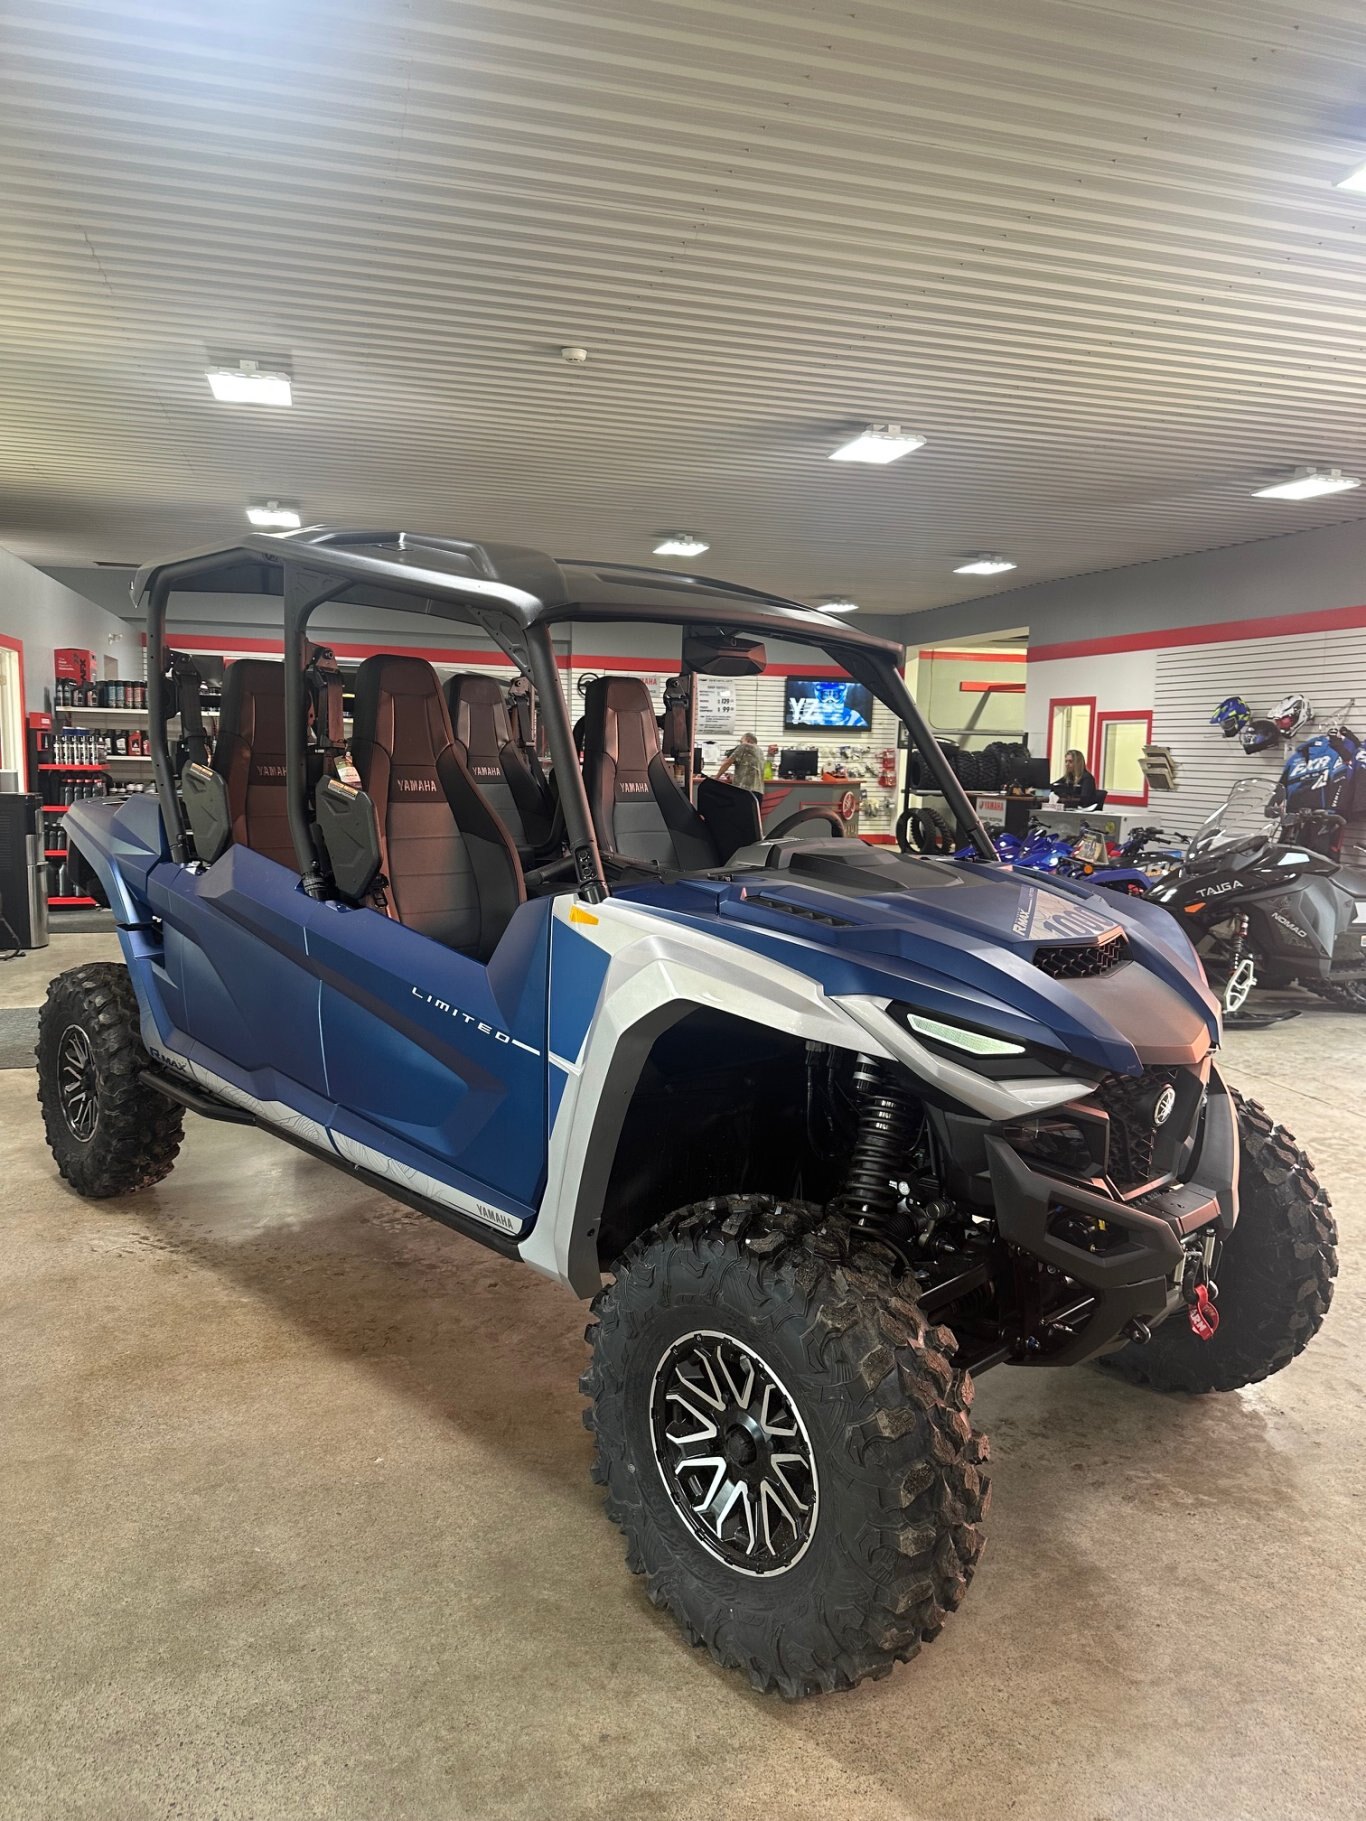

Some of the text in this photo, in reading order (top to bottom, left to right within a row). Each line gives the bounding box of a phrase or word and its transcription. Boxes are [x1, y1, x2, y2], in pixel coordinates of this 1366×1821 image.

[257, 766, 286, 776] YAMAH
[472, 766, 501, 776] YAMAHA
[397, 779, 437, 792] YAMAHA
[620, 782, 649, 793] YAMAHA
[1196, 880, 1243, 897] TAIGA
[1043, 906, 1114, 937] 1000
[1271, 912, 1308, 938] NOMAD
[412, 987, 510, 1044] LIMITED
[476, 1203, 514, 1230] YAMAHA
